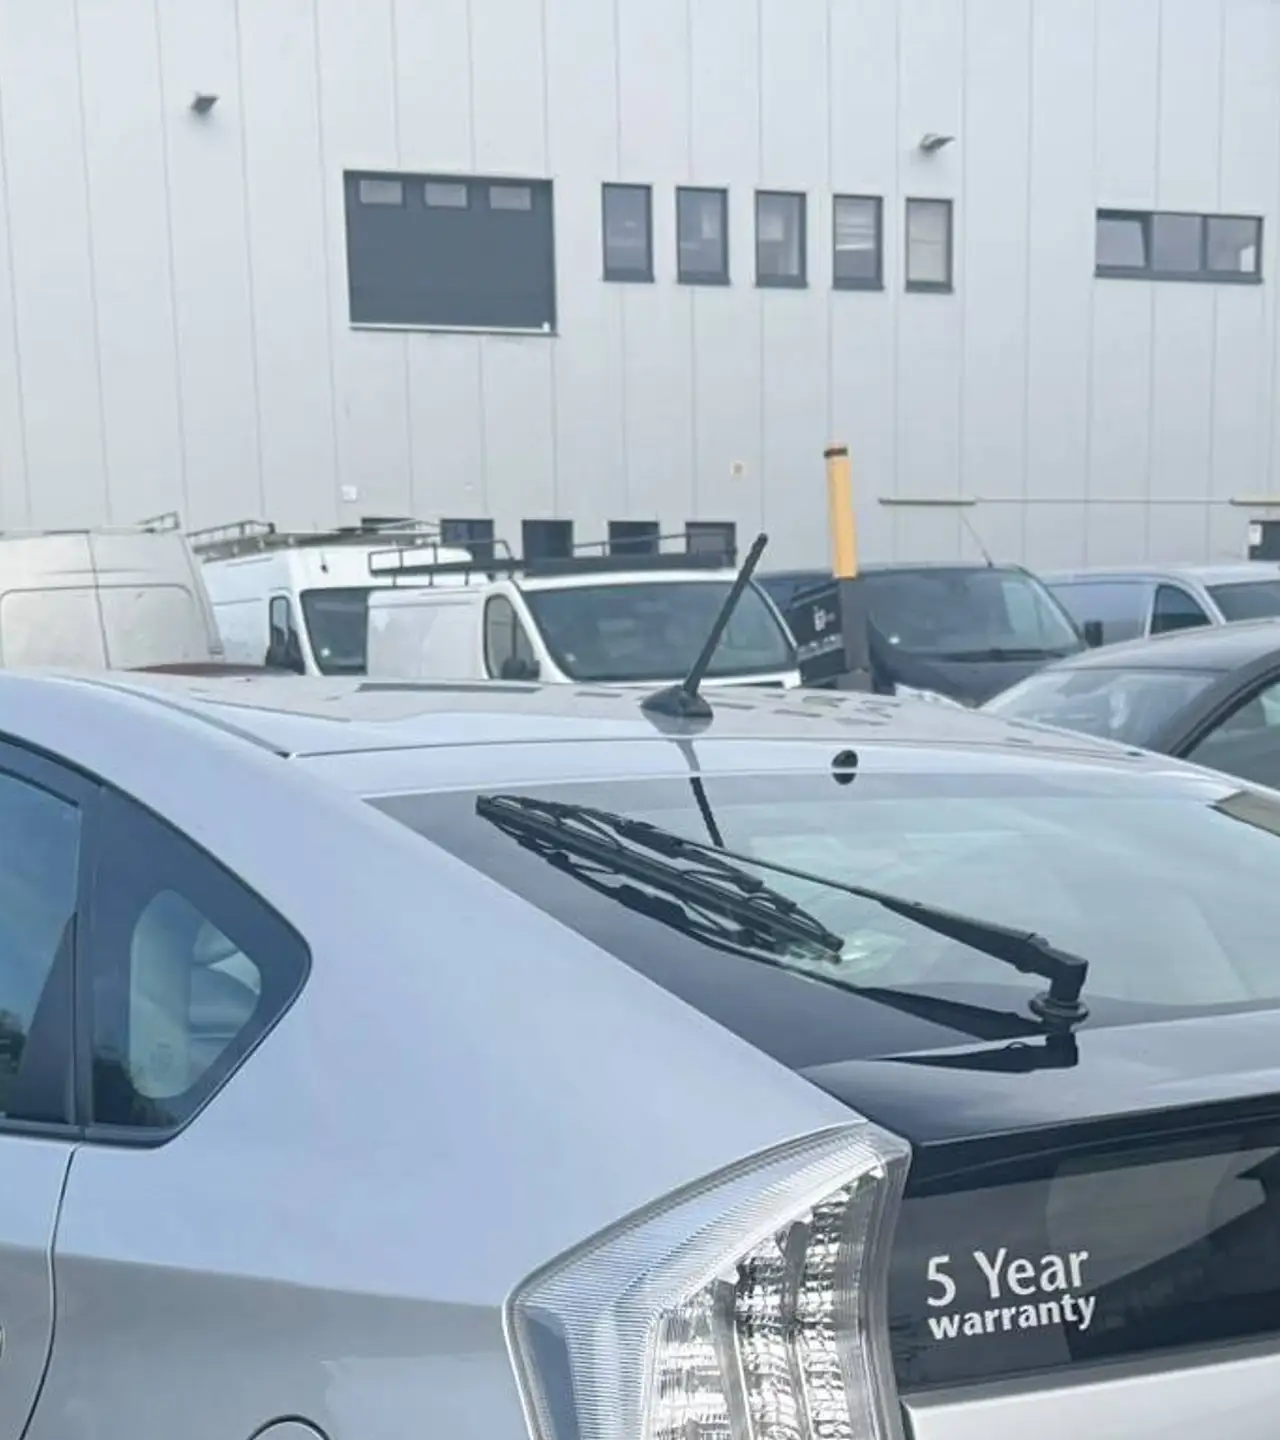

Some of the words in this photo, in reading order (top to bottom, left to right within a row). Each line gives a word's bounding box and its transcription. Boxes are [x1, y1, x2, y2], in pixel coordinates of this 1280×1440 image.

[926, 1254, 957, 1307] 5
[973, 1247, 1089, 1300] Year
[928, 1293, 1096, 1341] warranty
